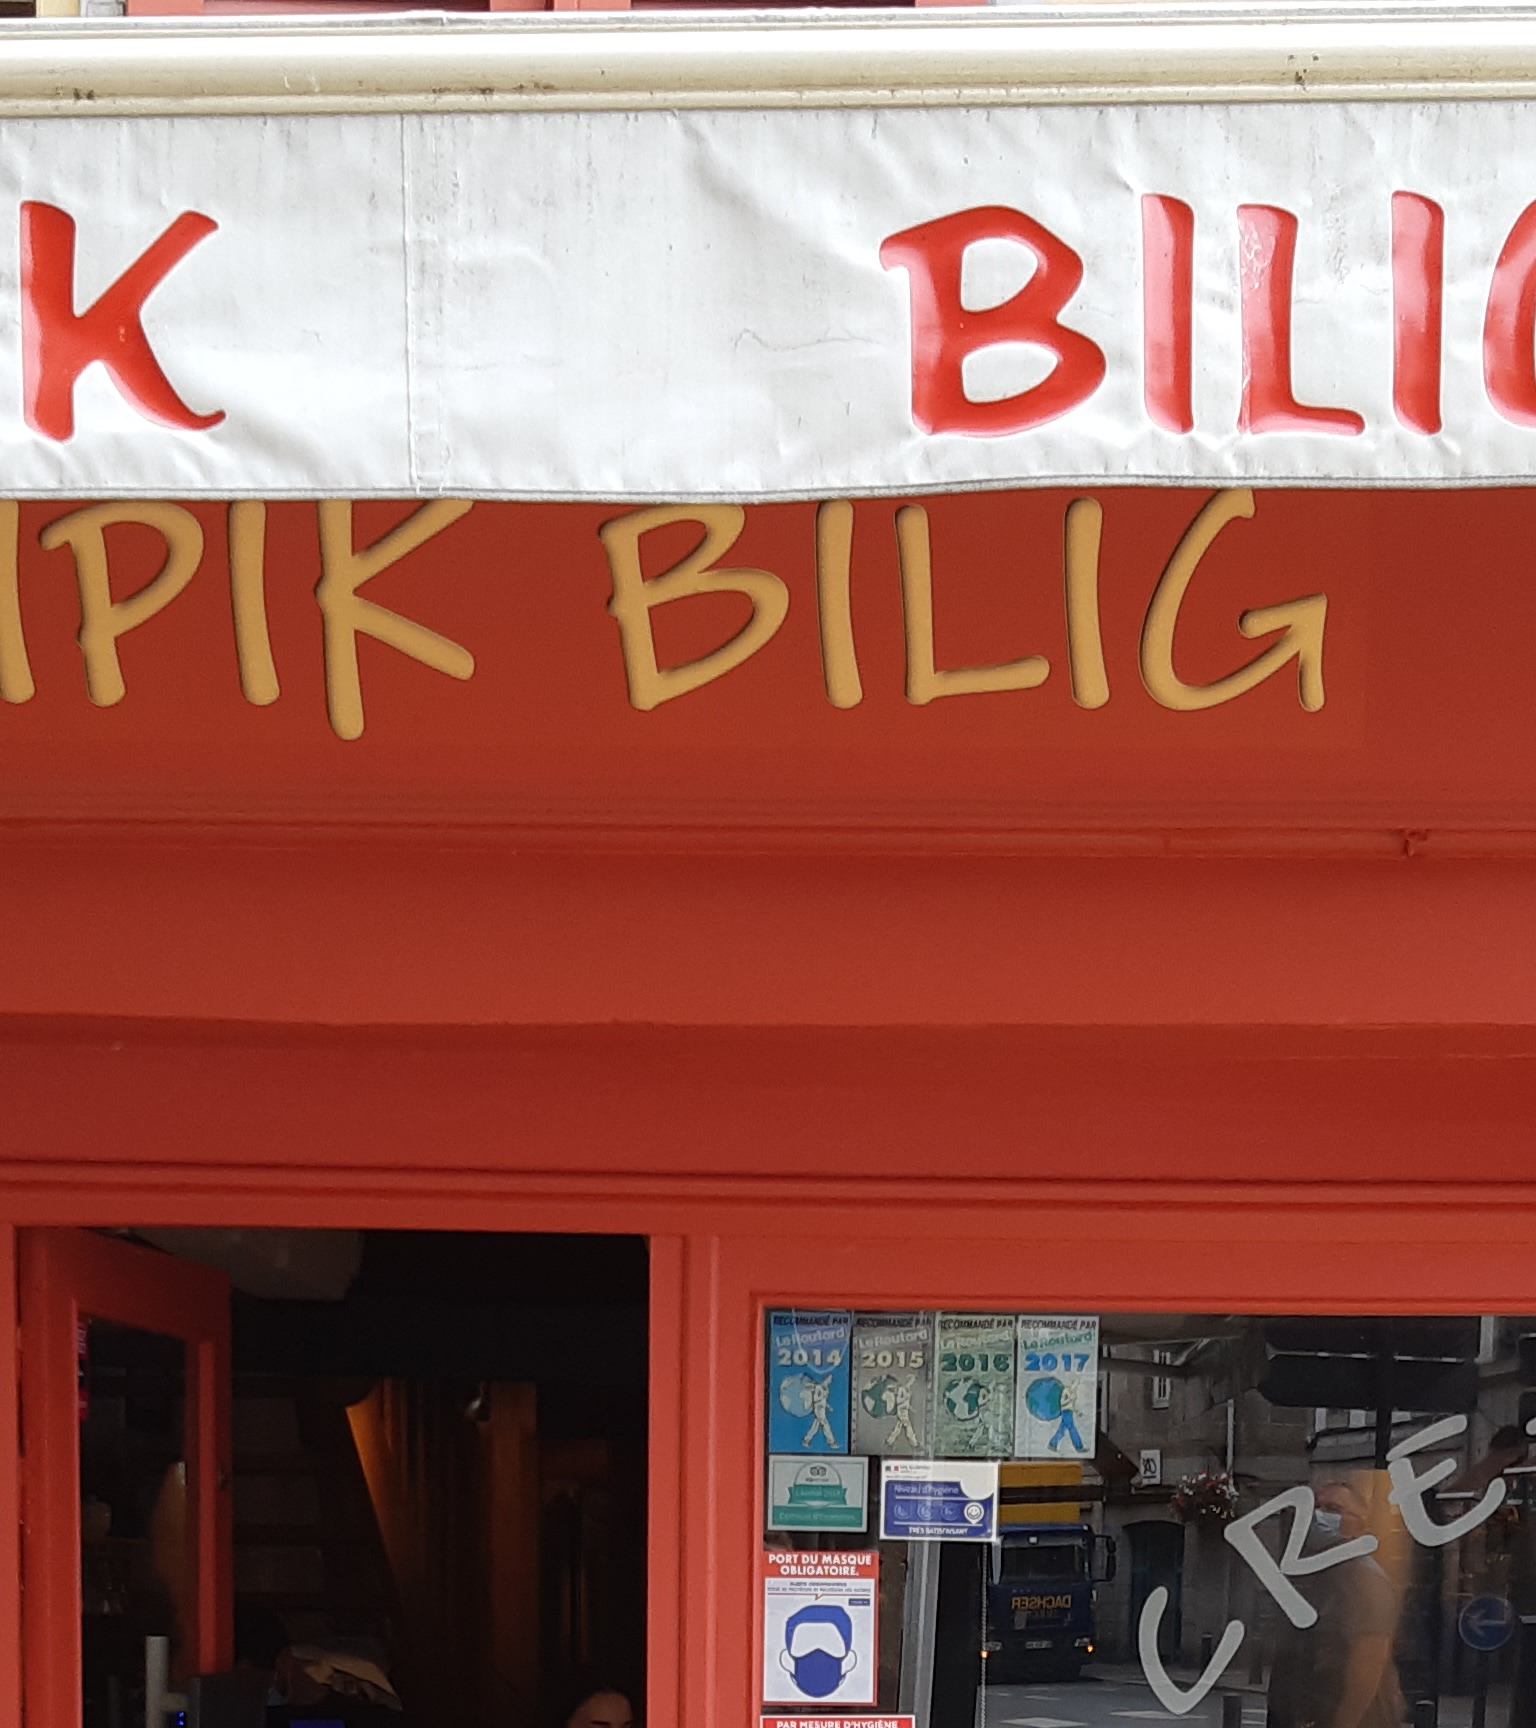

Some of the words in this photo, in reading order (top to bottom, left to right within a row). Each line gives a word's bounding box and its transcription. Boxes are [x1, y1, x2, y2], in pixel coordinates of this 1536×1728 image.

[598, 488, 1328, 712] BILIG
[778, 1350, 843, 1367] 2014
[862, 1350, 924, 1368] 2015
[941, 1352, 1011, 1372] 2016
[1024, 1352, 1090, 1372] 2017
[768, 1553, 799, 1564] PORT
[801, 1553, 819, 1565] DU
[821, 1554, 872, 1565] MASQUE
[780, 1565, 860, 1576] OBLIGATOIRE.
